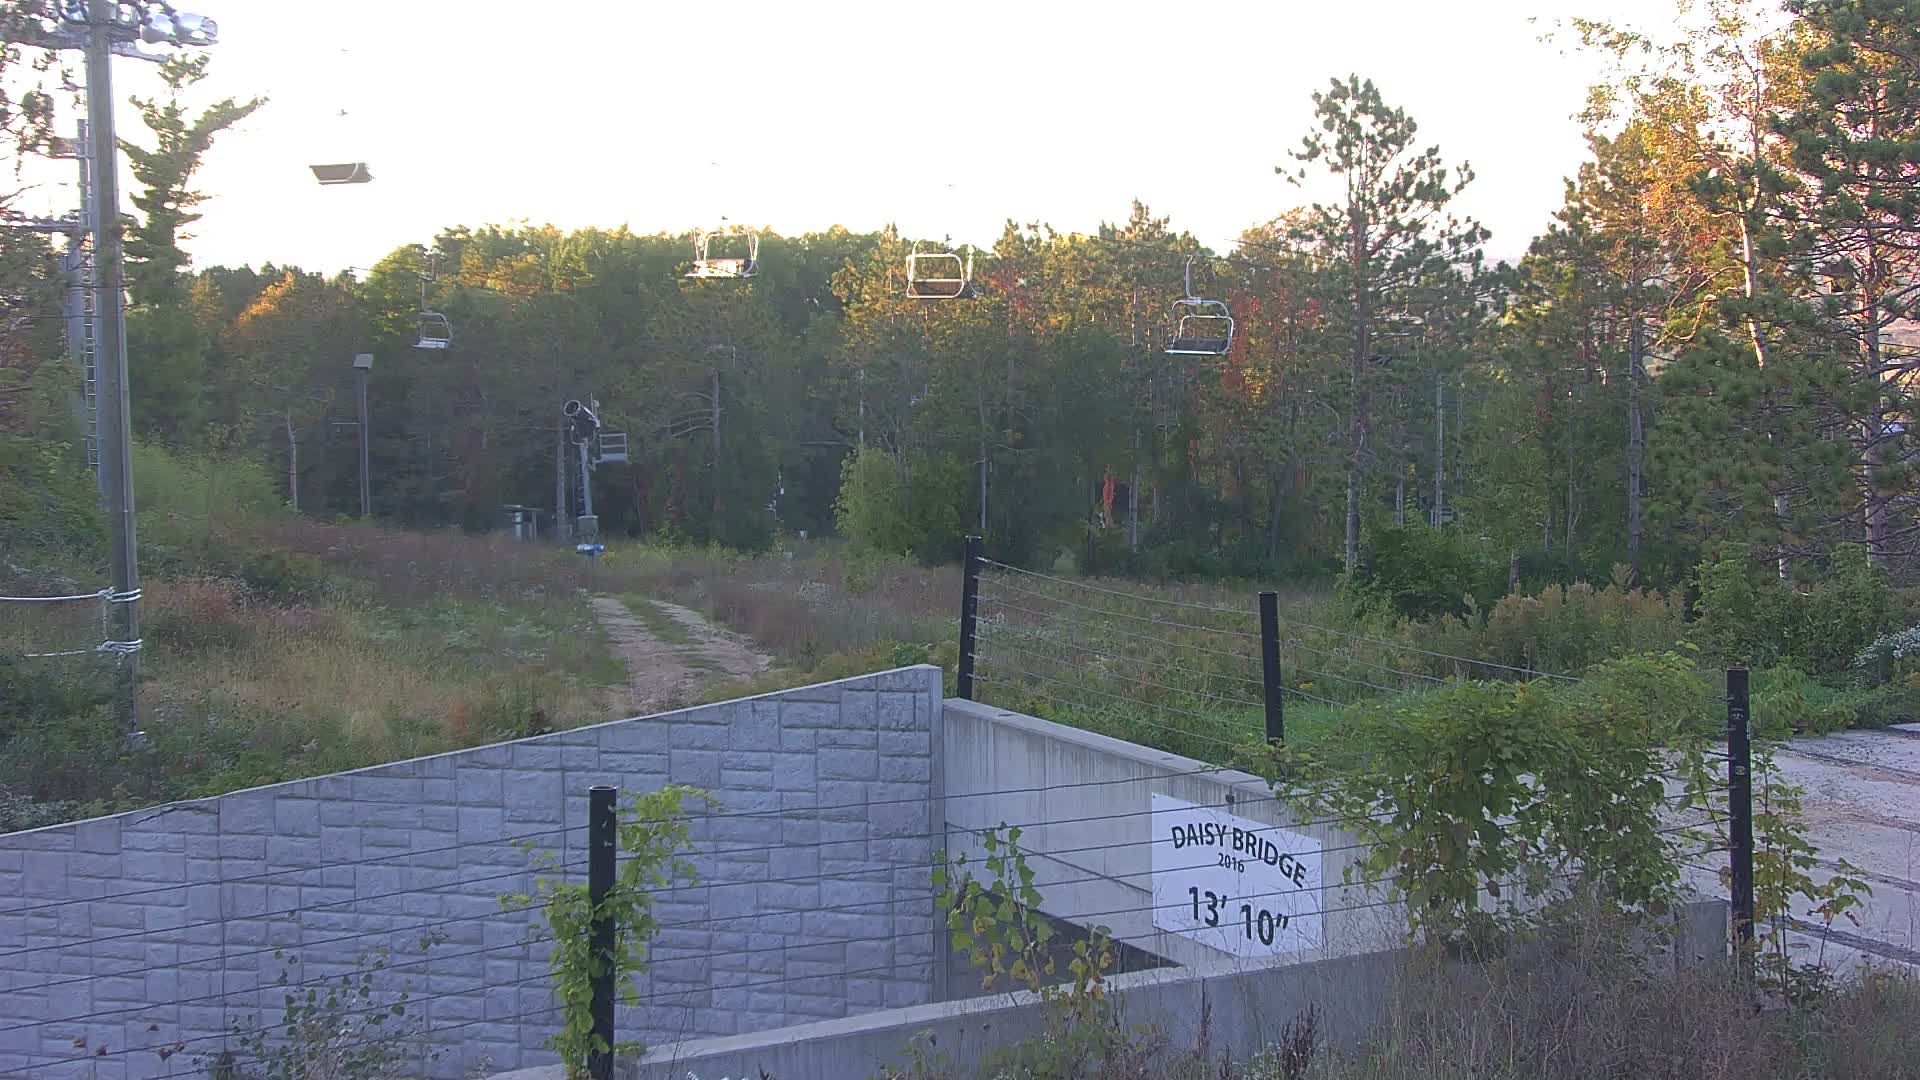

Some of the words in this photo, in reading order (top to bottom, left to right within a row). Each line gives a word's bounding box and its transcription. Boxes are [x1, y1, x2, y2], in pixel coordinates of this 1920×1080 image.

[1171, 823, 1227, 848] DAISY
[1232, 827, 1307, 888] BRIDGE
[1218, 853, 1245, 873] 2016
